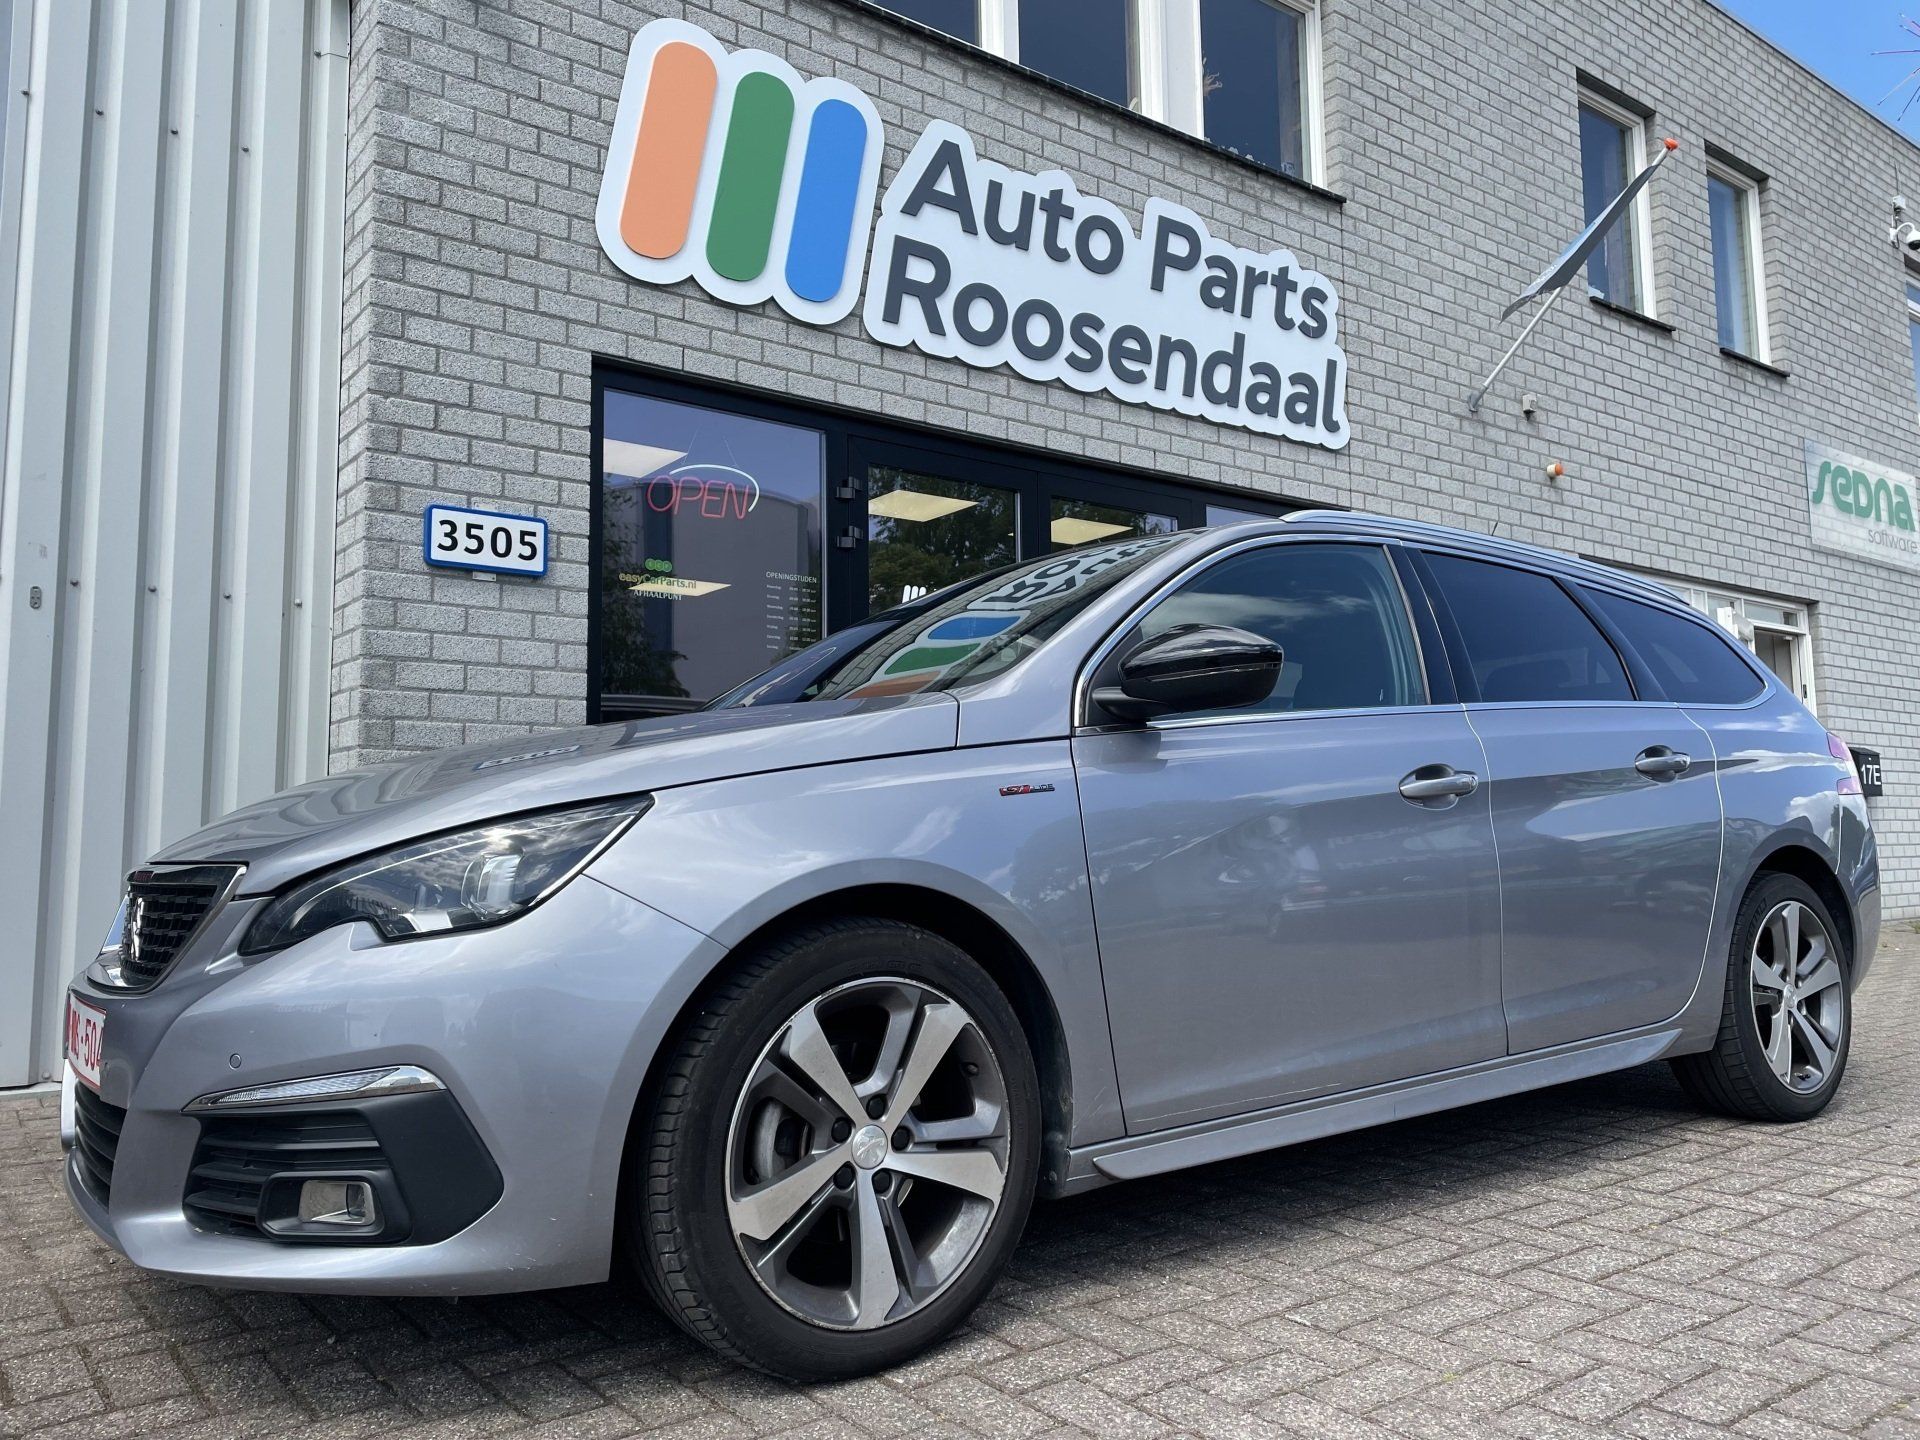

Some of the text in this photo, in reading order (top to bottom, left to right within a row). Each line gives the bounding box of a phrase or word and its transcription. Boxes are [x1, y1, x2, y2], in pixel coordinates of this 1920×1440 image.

[900, 139, 1329, 338] Auto Parts
[882, 234, 1341, 433] Roosendaal
[646, 475, 750, 519] OPEN
[437, 519, 538, 561] 3505
[1867, 529, 1918, 555] software
[1861, 764, 1882, 785] 17E
